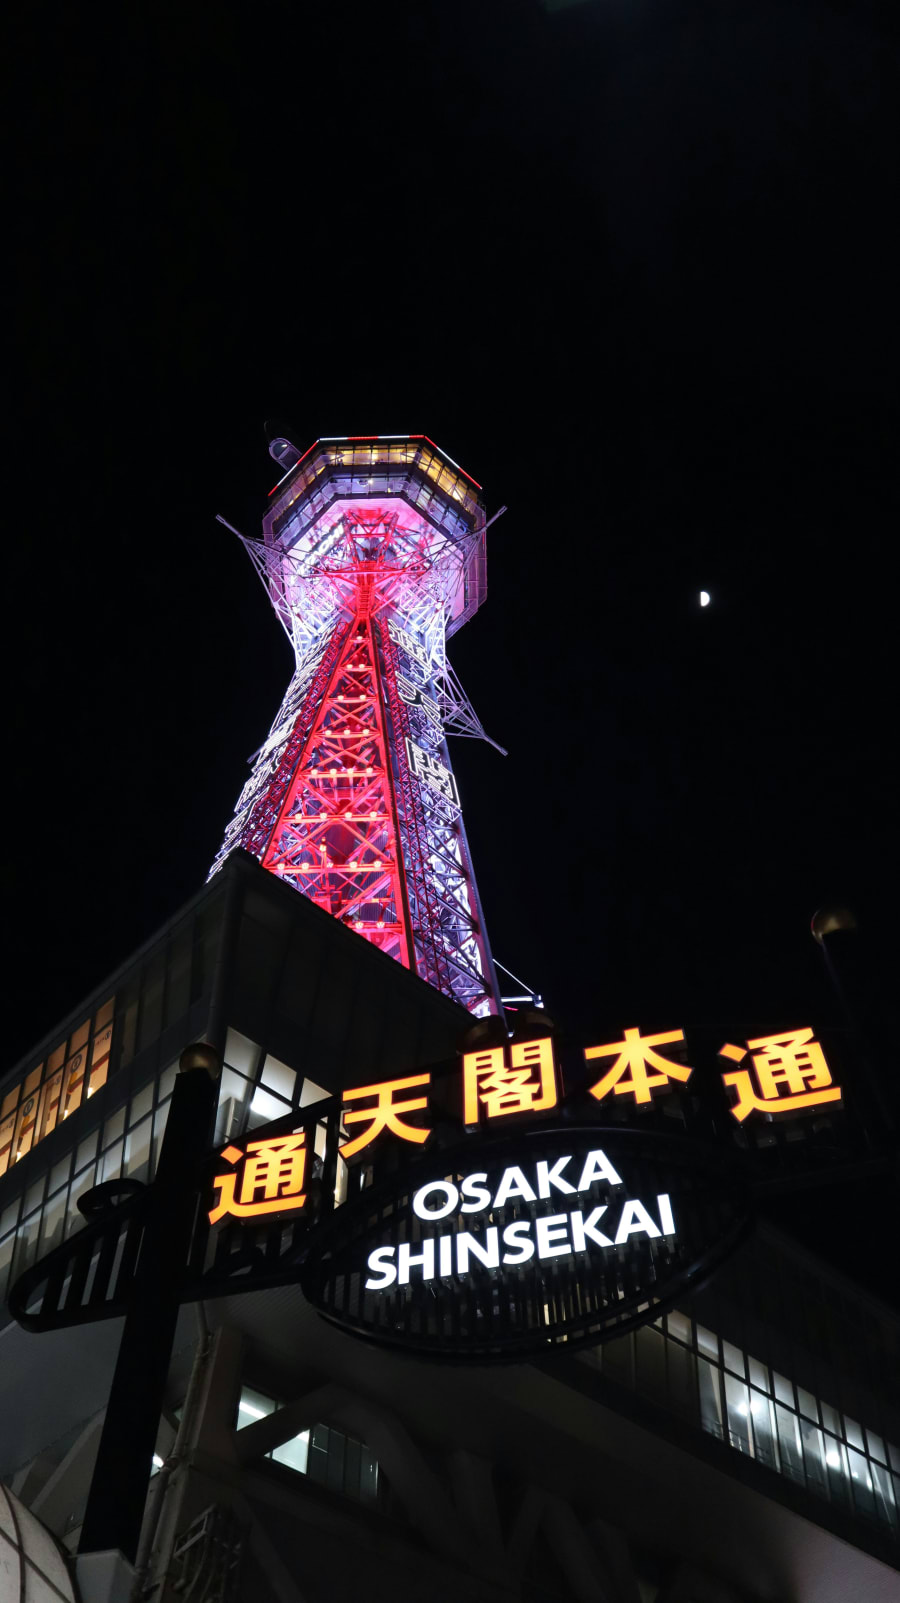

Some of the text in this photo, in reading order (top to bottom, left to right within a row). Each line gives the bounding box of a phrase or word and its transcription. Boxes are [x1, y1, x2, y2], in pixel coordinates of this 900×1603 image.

[208, 1027, 842, 1225] 通天閣本通
[412, 1149, 623, 1221] OSAKA
[365, 1193, 676, 1290] SHINSEKAI
